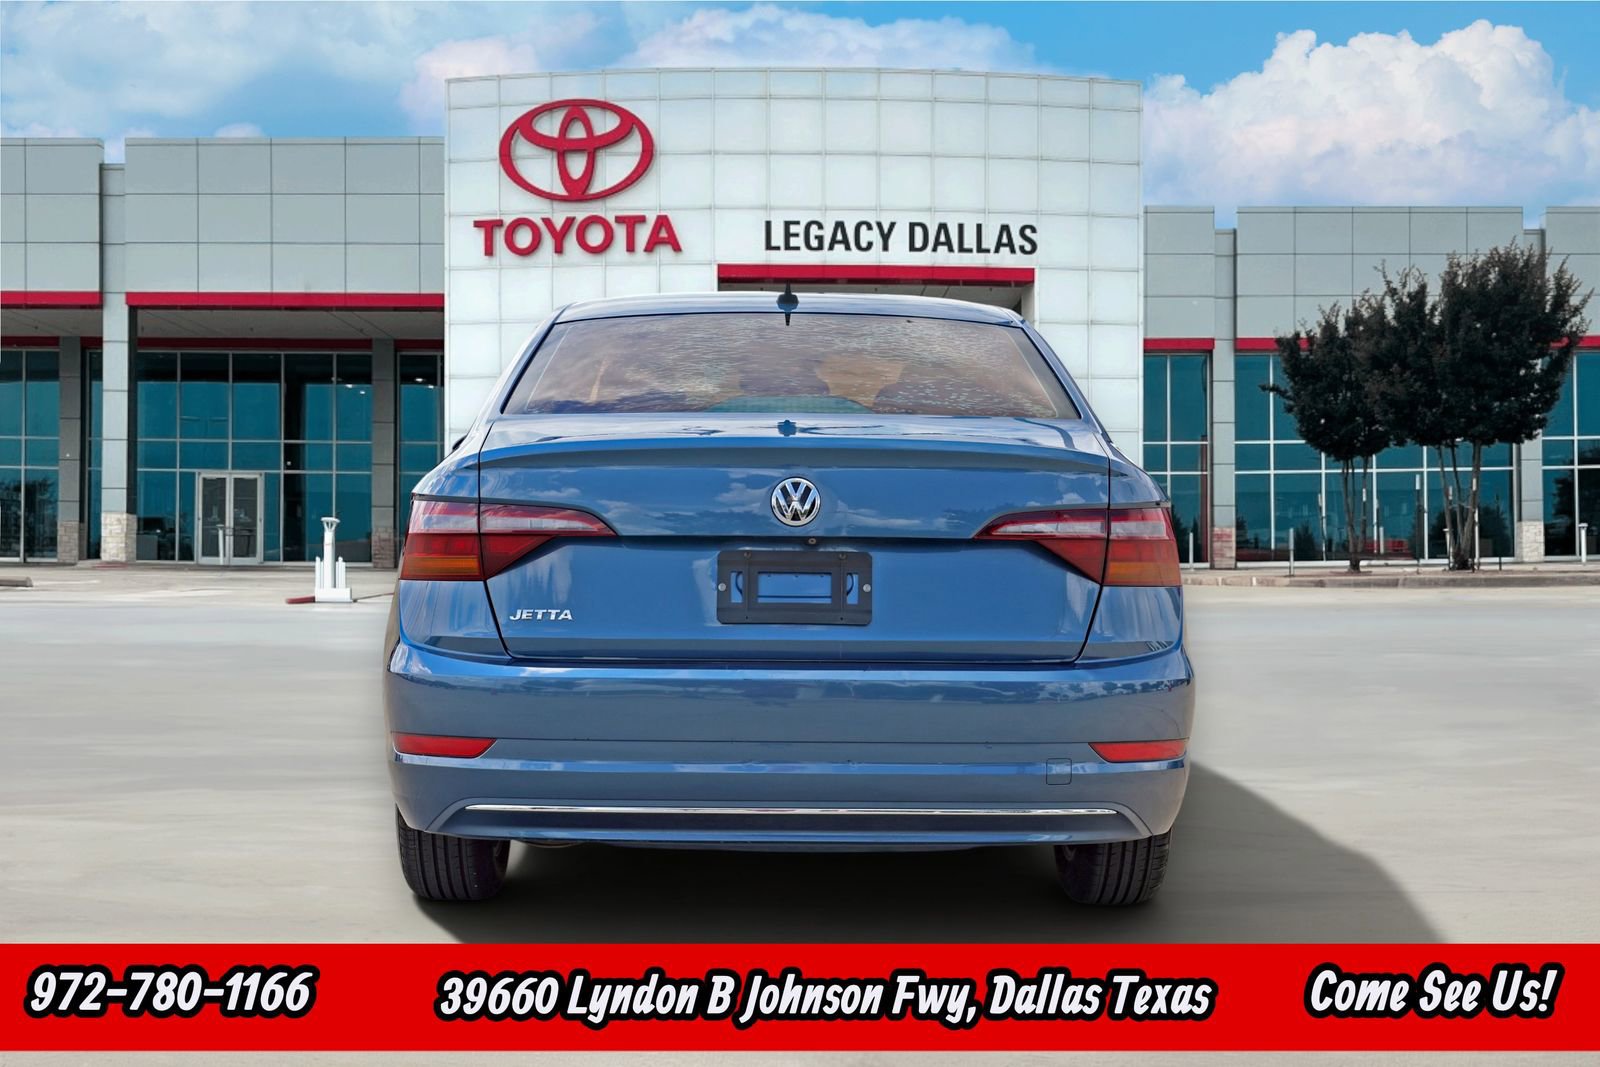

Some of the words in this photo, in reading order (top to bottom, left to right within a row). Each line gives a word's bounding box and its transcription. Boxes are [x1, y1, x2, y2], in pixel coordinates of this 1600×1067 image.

[474, 214, 682, 257] TOYOTA
[764, 220, 897, 253] LEGACY
[908, 221, 1038, 255] DALLAS
[771, 477, 820, 526] VW
[509, 608, 573, 621] JETTA
